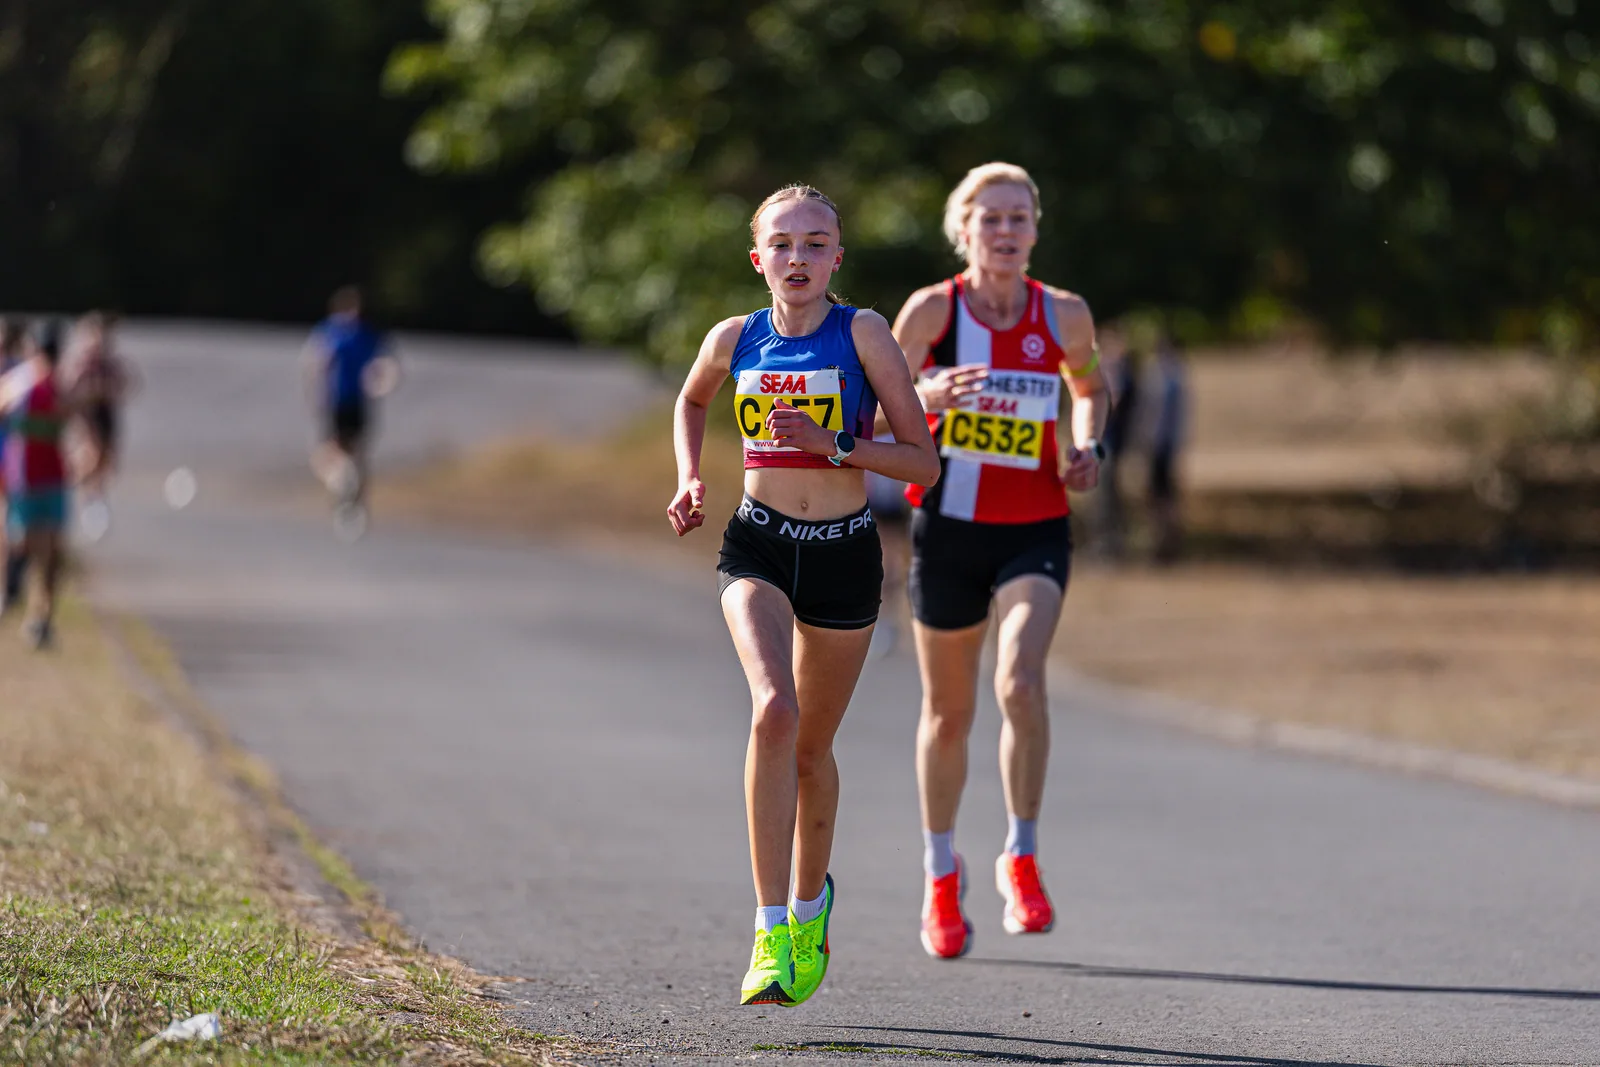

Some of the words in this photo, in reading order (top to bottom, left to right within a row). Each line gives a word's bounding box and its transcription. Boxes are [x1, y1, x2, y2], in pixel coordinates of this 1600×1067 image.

[760, 373, 807, 394] SEAA
[986, 374, 1055, 397] HESTER
[740, 397, 835, 438] C7
[977, 395, 1019, 416] SEAA
[951, 412, 1036, 455] C532
[740, 498, 770, 525] RO
[779, 521, 845, 541] NIKE
[848, 508, 872, 535] PR
